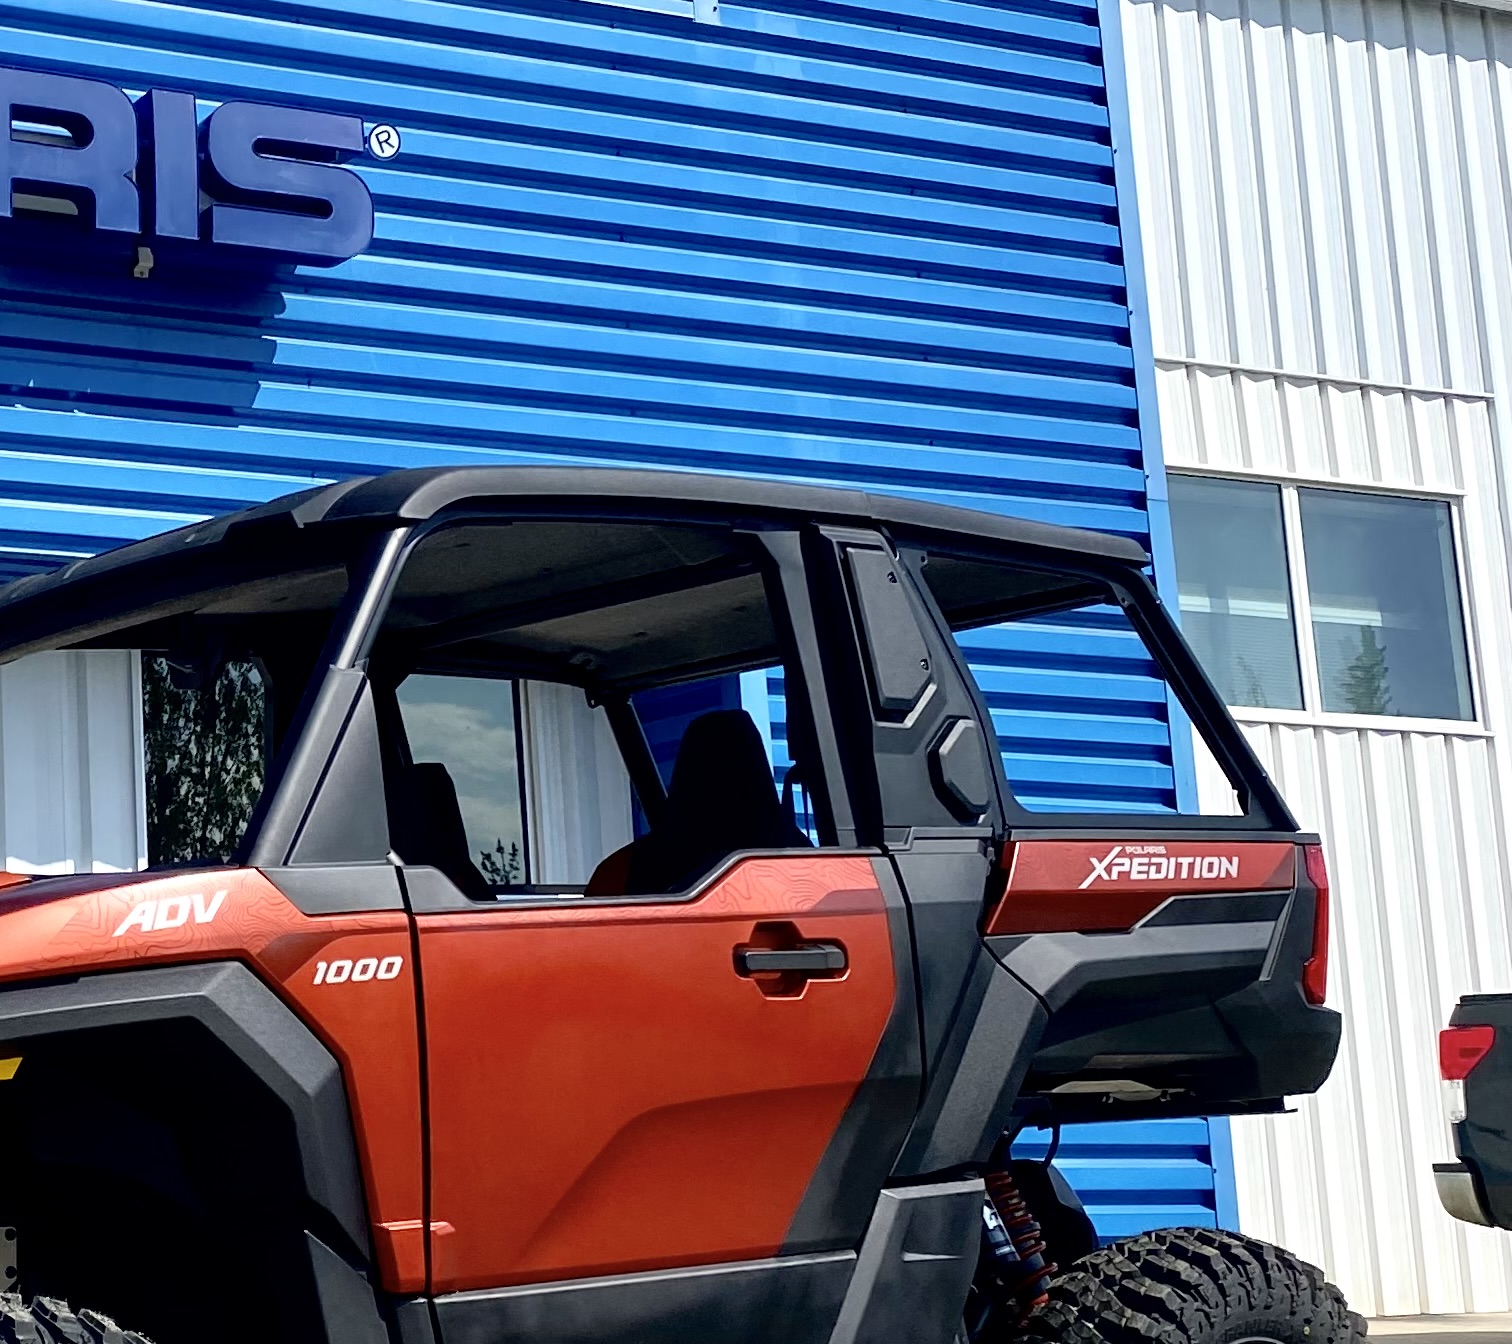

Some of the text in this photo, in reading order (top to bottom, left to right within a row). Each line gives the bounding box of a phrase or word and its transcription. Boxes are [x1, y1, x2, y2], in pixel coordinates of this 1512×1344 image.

[1078, 846, 1239, 890] XPEDITION
[1125, 846, 1167, 855] POLARIS
[112, 890, 228, 938] ADV
[313, 956, 404, 986] 1000
